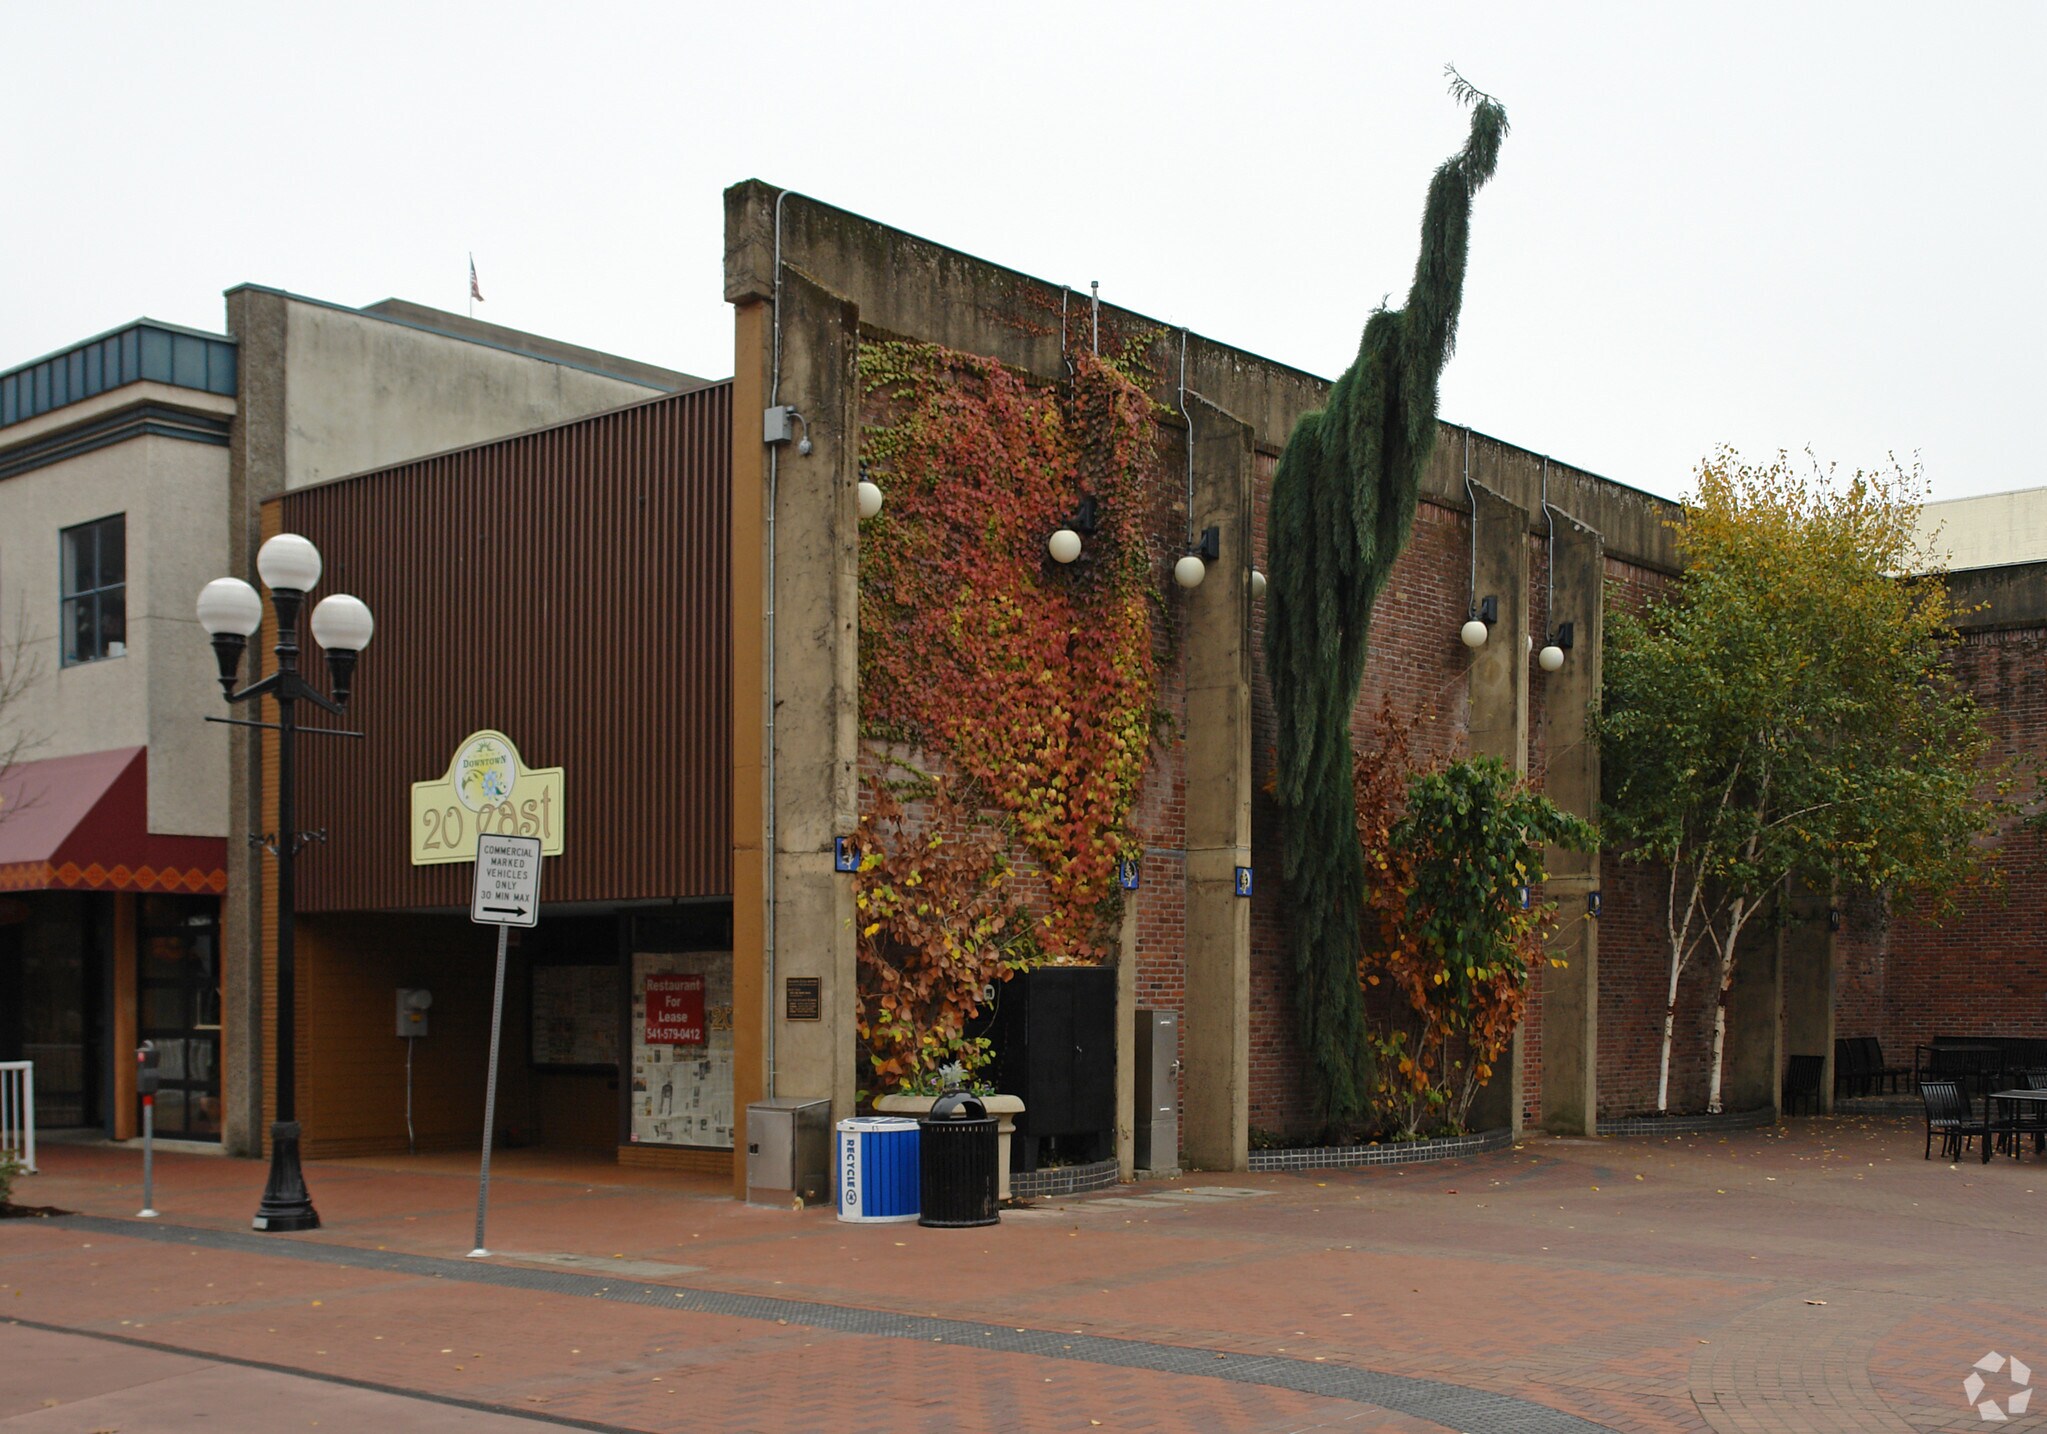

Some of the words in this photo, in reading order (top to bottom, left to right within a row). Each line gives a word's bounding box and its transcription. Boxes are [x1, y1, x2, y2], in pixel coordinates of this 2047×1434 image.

[463, 755, 507, 768] DOWNTOWN
[422, 806, 464, 850] 20
[484, 845, 533, 857] COMMERCIAL
[491, 858, 525, 868] MARKED
[486, 868, 528, 880] VEHICLES
[495, 880, 517, 890] ONLY
[481, 891, 492, 900] 30
[495, 891, 510, 901] MIN
[513, 892, 530, 903] MAX
[647, 979, 700, 992] Restaurant
[665, 995, 682, 1008] For
[658, 1010, 688, 1023] Lease
[647, 1027, 700, 1041] 541-579-0412
[846, 1139, 855, 1188] RECYCLE
